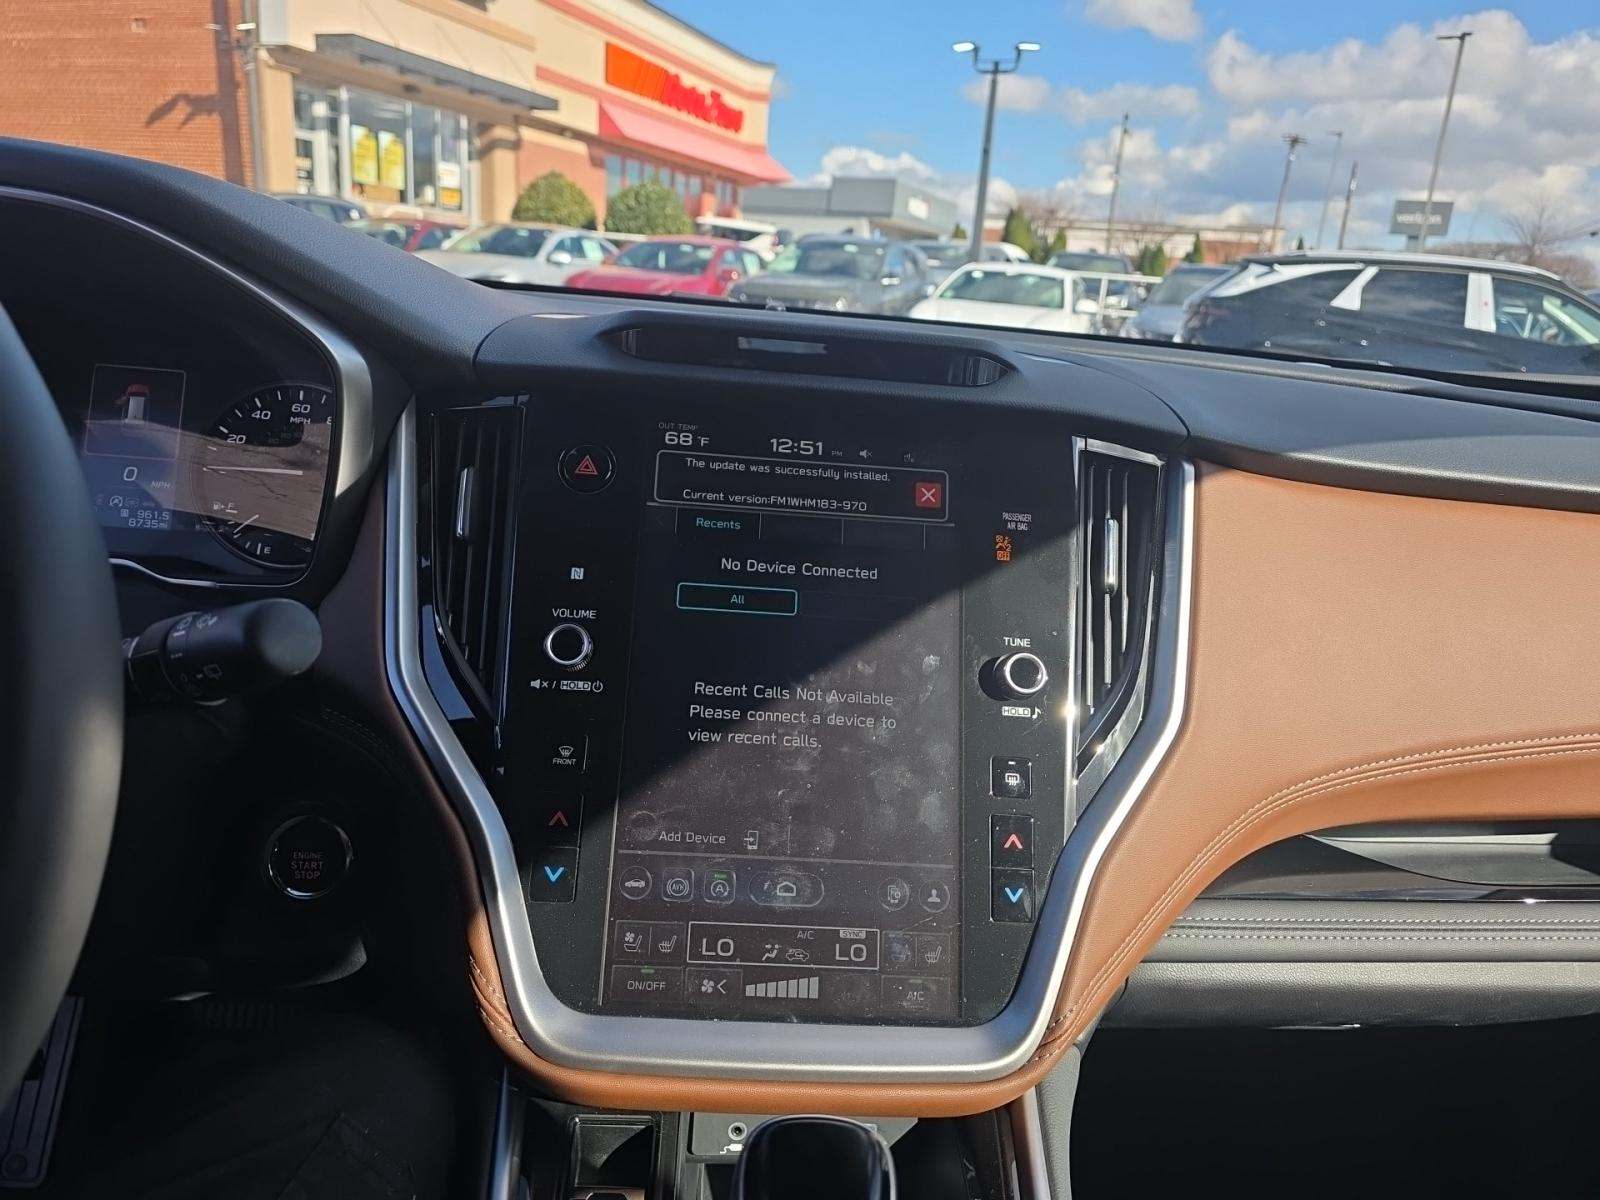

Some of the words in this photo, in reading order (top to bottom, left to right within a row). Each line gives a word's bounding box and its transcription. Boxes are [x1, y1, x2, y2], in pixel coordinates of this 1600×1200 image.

[291, 403, 310, 413] 60
[251, 410, 271, 420] 40
[290, 416, 311, 425] MPH
[658, 422, 674, 430] OUT
[678, 423, 698, 431] TEMP
[227, 434, 246, 444] 20
[664, 431, 693, 446] 68
[770, 438, 823, 456] 12:51
[123, 466, 138, 481] 0
[685, 457, 706, 468] The
[709, 459, 746, 472] update
[750, 464, 770, 473] was
[775, 464, 840, 480] successfully
[844, 469, 891, 482] installed.
[683, 489, 725, 501] Current
[1002, 512, 1032, 522] PASSENGER
[696, 517, 741, 530] Recents
[1007, 522, 1016, 530] AIR
[1017, 522, 1028, 531] BAG
[264, 546, 271, 554] E
[721, 558, 741, 571] No
[746, 559, 796, 574] Device
[802, 563, 878, 580] Connected
[730, 594, 744, 605] All
[552, 608, 596, 619] VOLUME
[1003, 636, 1031, 647] TUNE
[561, 681, 591, 690] HOLD
[694, 681, 748, 697] Recent
[753, 685, 790, 700] Calls
[796, 687, 823, 701] Not
[828, 689, 894, 706] Available
[689, 705, 741, 720] Please
[747, 710, 807, 724] connect
[812, 714, 821, 724] a
[827, 713, 875, 728] device
[882, 716, 897, 729] to
[1002, 706, 1031, 717] HOLD
[688, 729, 722, 742] view
[728, 732, 777, 745] recent
[783, 734, 822, 748] calls.
[552, 758, 576, 766] FRONT
[659, 831, 681, 842] Add
[686, 832, 726, 844] Device
[291, 861, 323, 870] START
[294, 870, 321, 879] STOP
[796, 931, 815, 940] A/C
[841, 930, 865, 938] SYNC
[702, 938, 734, 956] LO
[835, 943, 867, 962] LO
[627, 980, 666, 991] ON/OFF
[906, 991, 924, 1001] A/C
